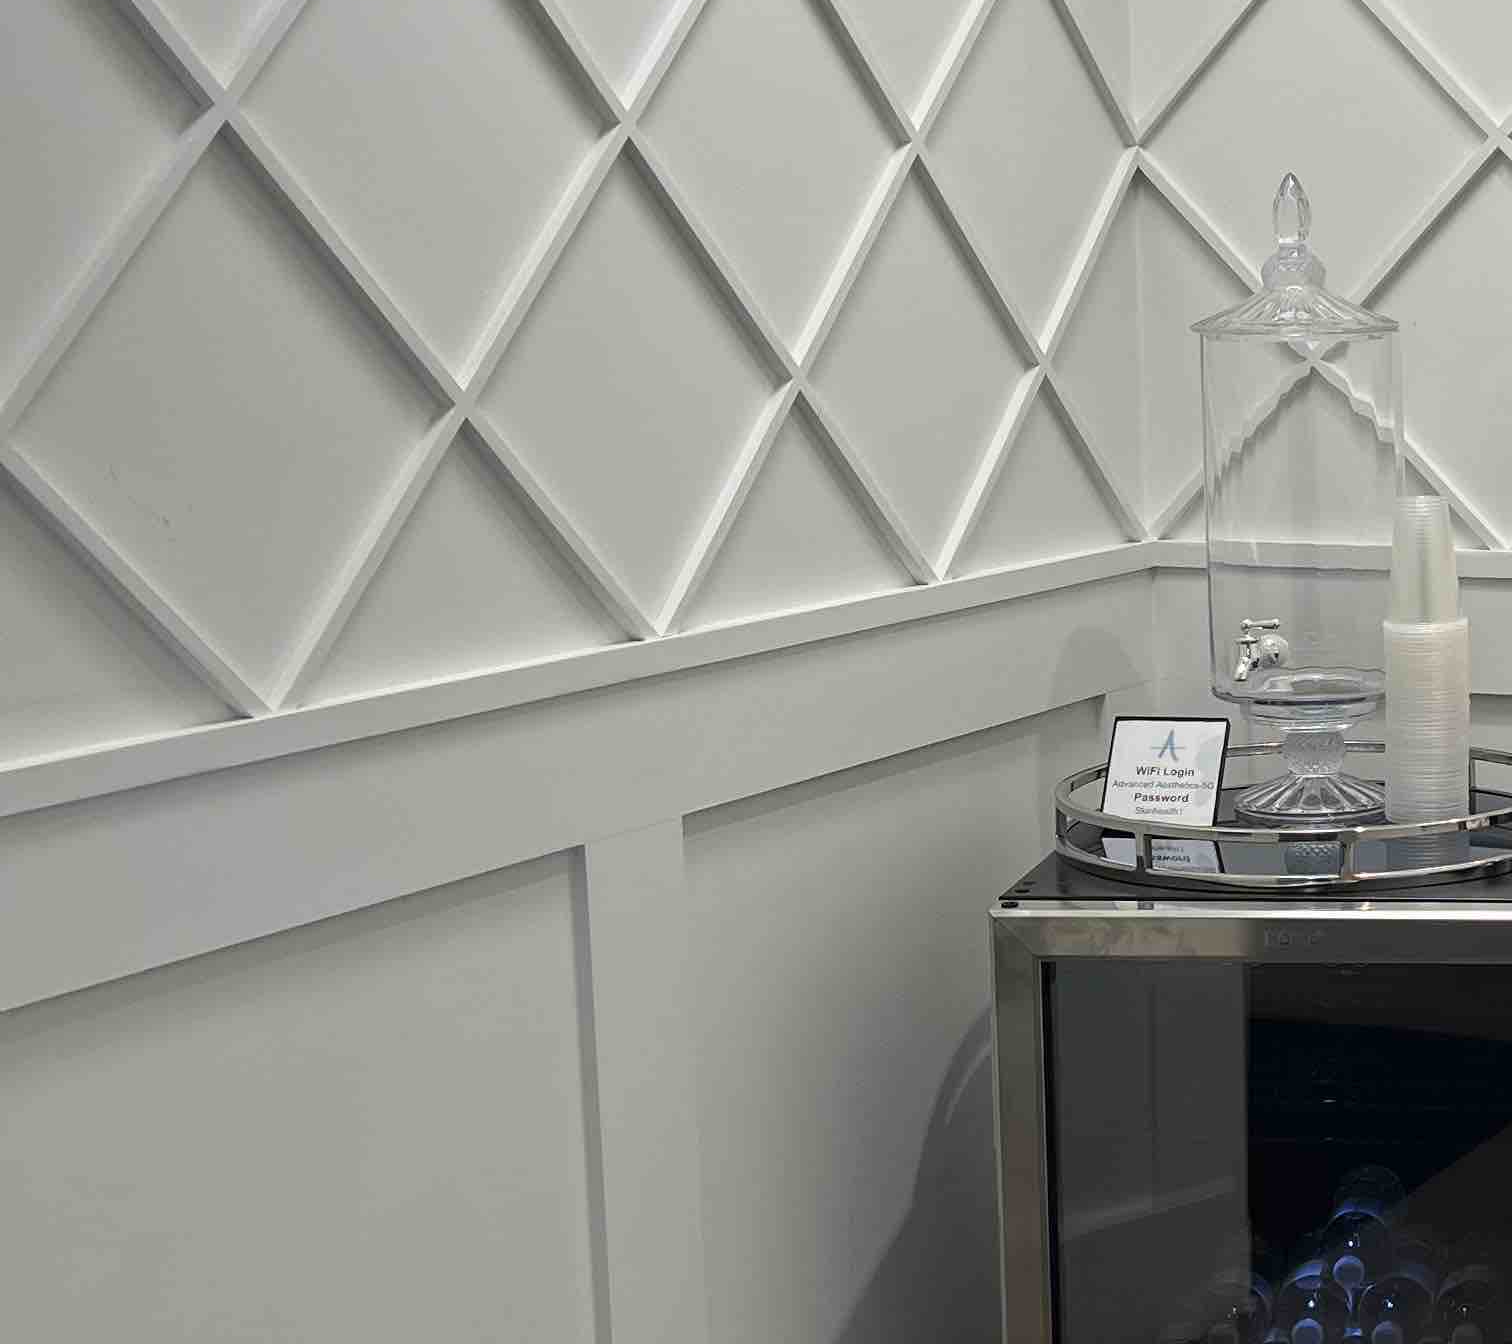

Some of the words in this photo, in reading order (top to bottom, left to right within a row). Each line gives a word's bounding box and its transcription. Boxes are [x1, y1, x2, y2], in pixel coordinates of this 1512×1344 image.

[1136, 766, 1161, 776] WiFi
[1164, 767, 1194, 778] Login
[1134, 793, 1189, 803] Password
